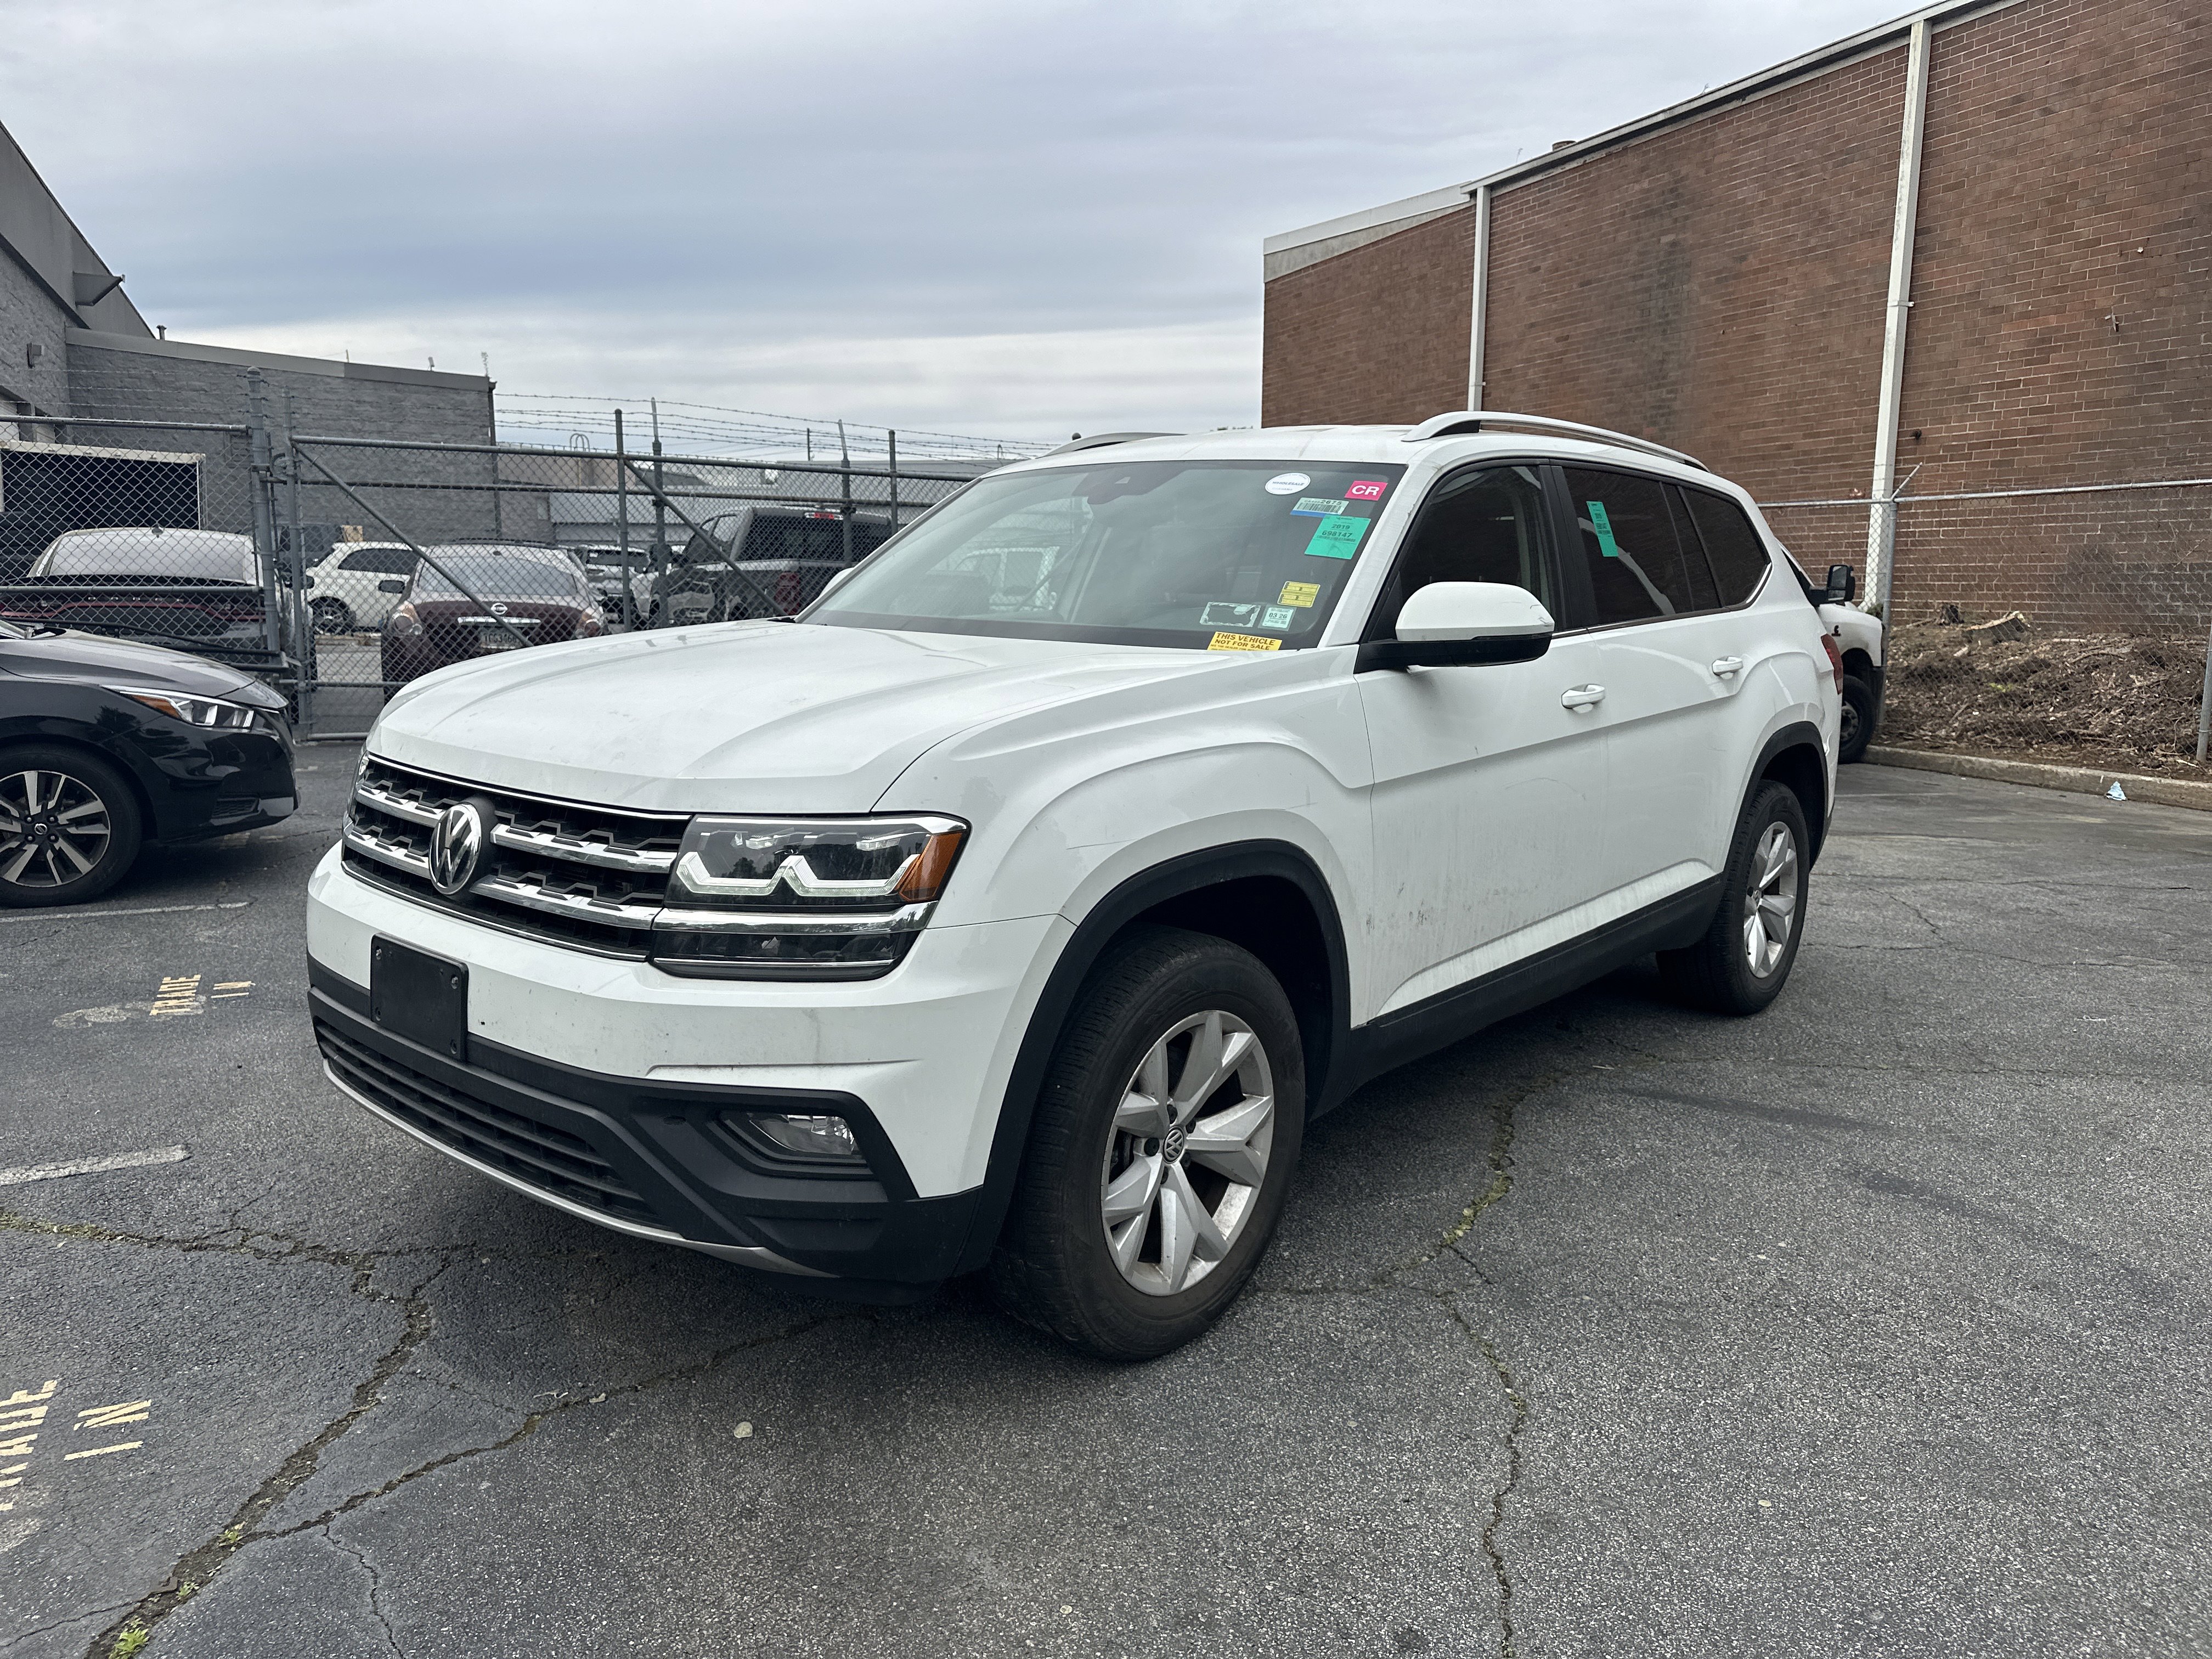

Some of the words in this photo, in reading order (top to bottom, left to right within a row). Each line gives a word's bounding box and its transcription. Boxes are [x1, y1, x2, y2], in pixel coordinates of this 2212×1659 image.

[1352, 485, 1380, 496] CR
[1322, 530, 1353, 538] 698147
[1238, 635, 1276, 646] VEHICLE
[149, 974, 201, 1015] TRADE
[211, 981, 253, 998] IN
[64, 1399, 151, 1461] IN
